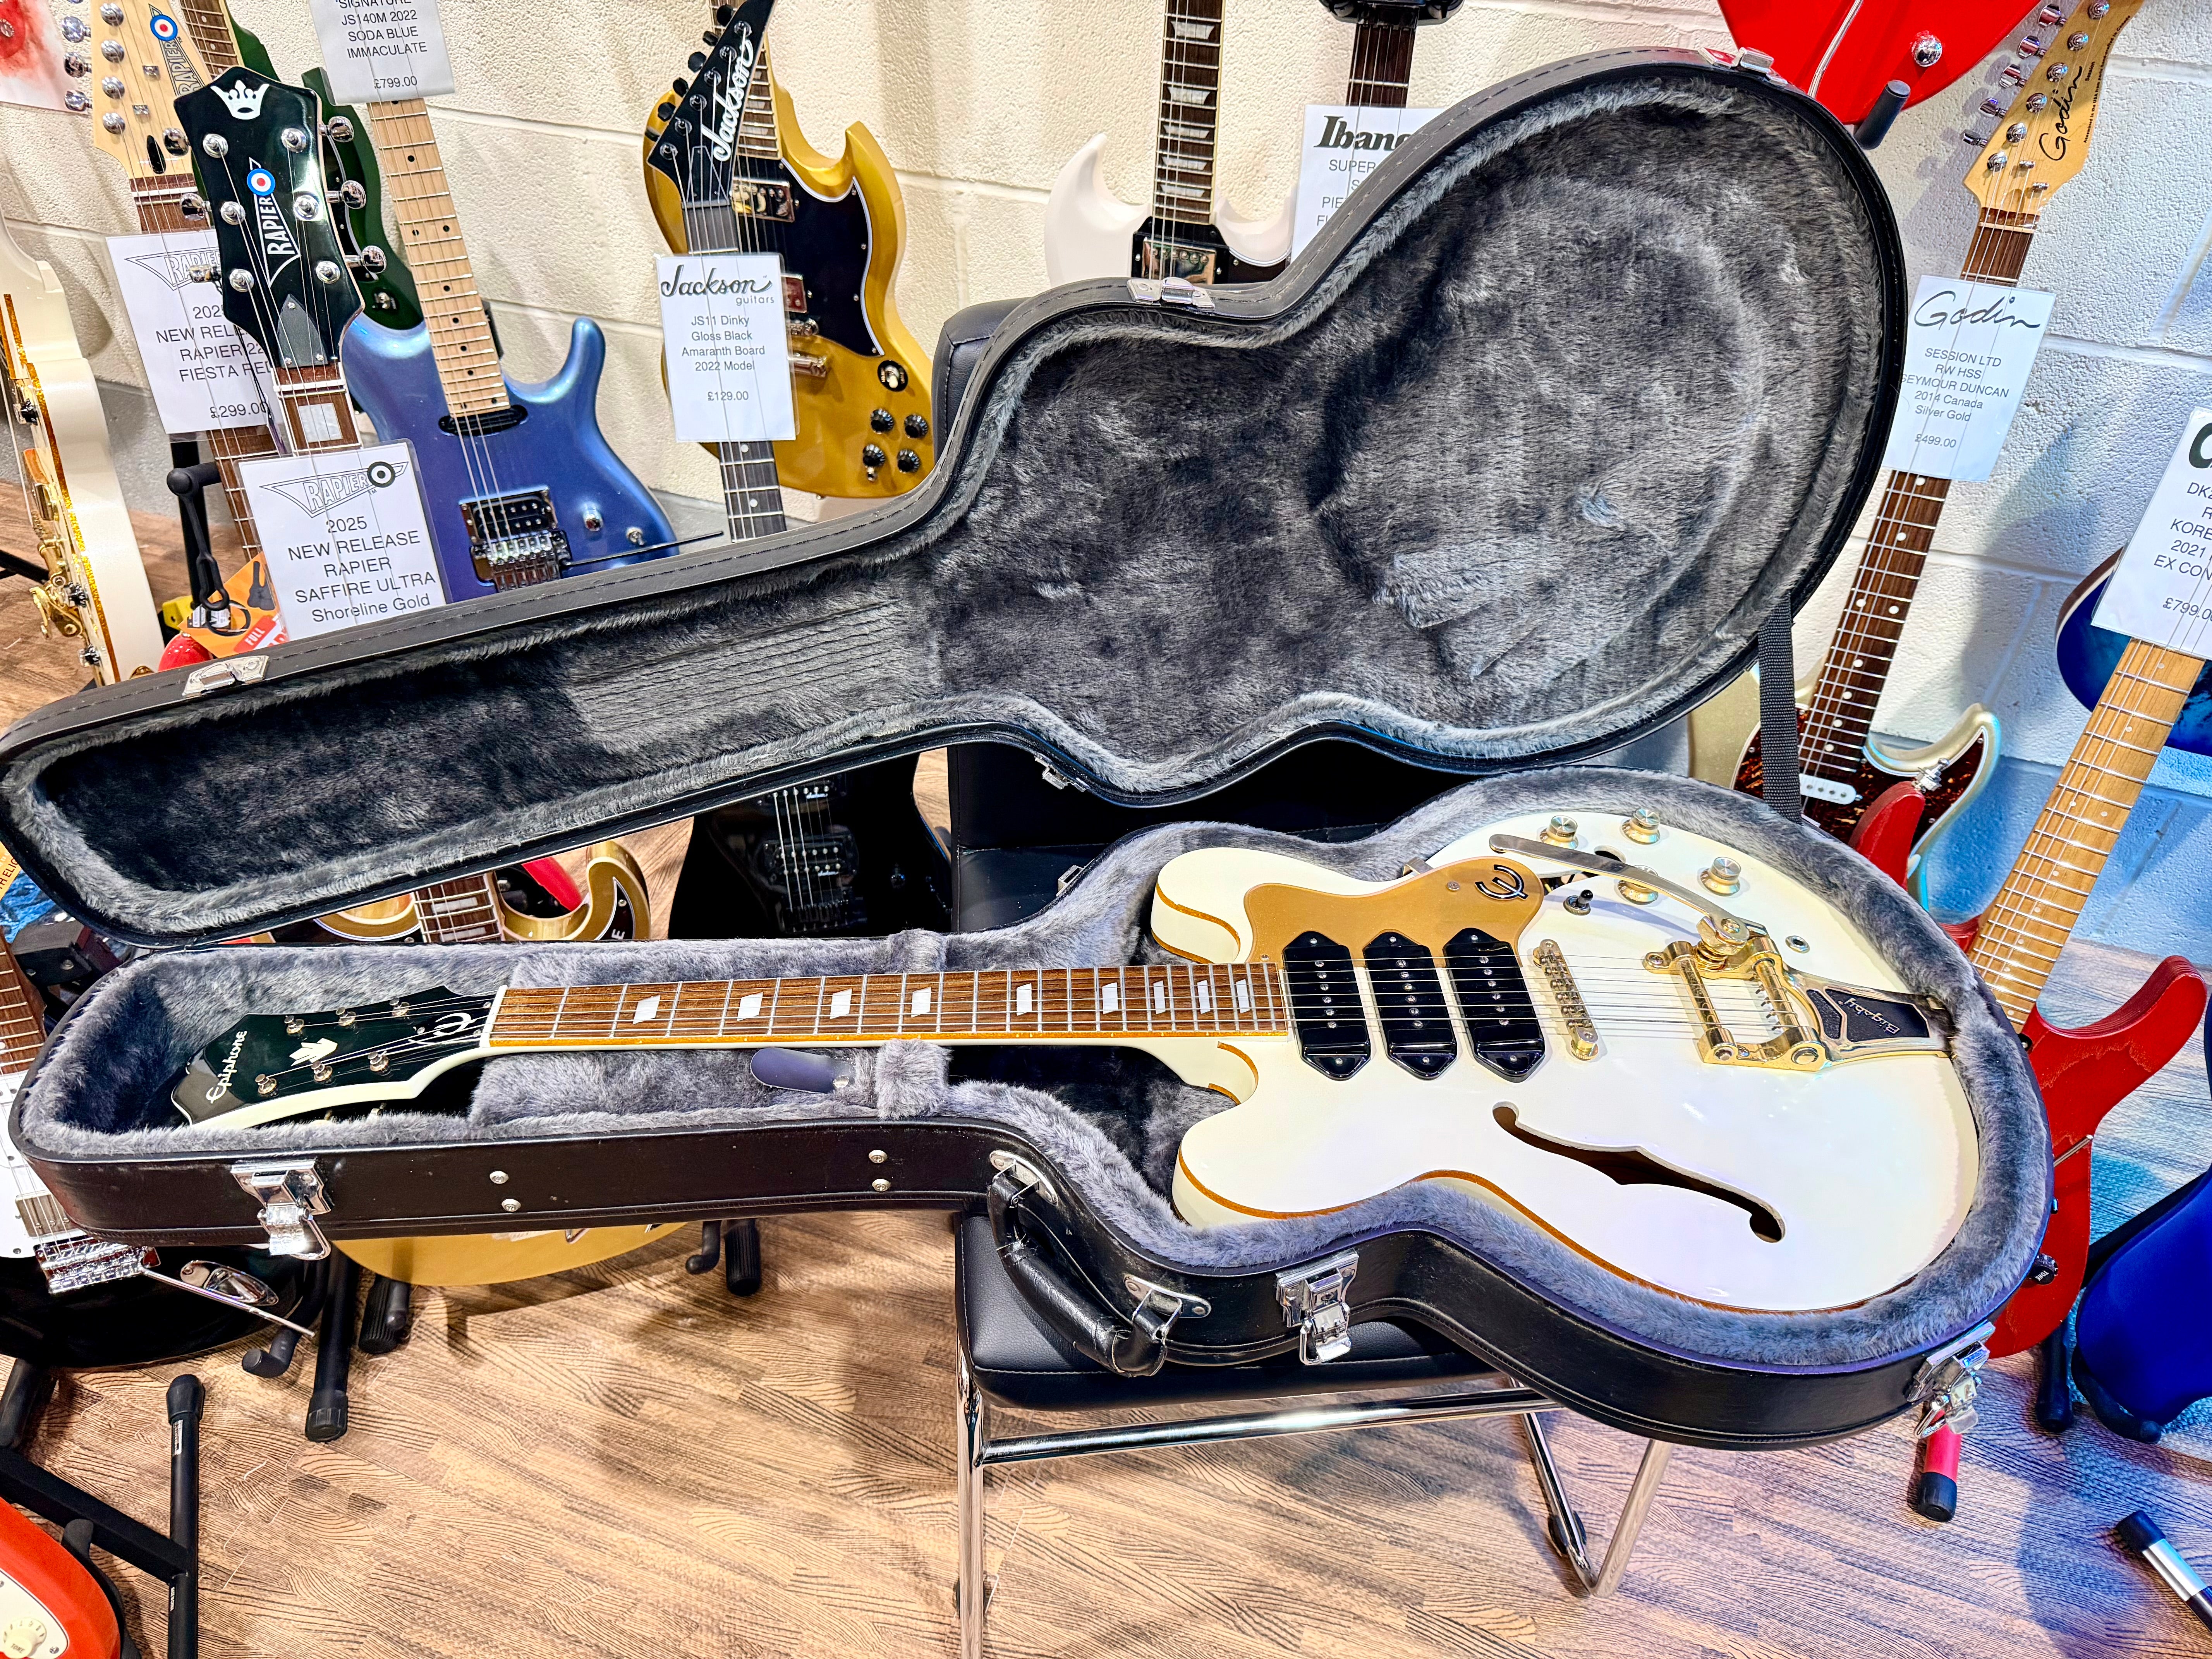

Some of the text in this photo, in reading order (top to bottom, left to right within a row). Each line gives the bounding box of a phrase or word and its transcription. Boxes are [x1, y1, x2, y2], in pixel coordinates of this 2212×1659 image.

[342, 10, 417, 25] JS140M 2022
[349, 26, 418, 41] SODA BLUE
[347, 42, 427, 58] IMMACULATE
[164, 39, 202, 95] RAPIER
[374, 76, 417, 89] £799.00
[701, 40, 753, 161] Jackson
[2039, 66, 2082, 161] Godin
[1329, 159, 1376, 173] SUPER
[1322, 197, 1346, 208] PIE
[259, 196, 295, 254] RAPIER
[661, 264, 773, 297] Jackson
[736, 295, 775, 306] guitars
[193, 305, 223, 319] 202
[1914, 291, 2040, 330] Godin
[691, 316, 749, 327] JS11 Dinky
[156, 325, 247, 343] NEW RELE
[692, 331, 752, 341] Gloss Black
[180, 345, 243, 361] RAPIER
[682, 346, 765, 356] Amaranth Board
[1925, 348, 2001, 367] SESSION LTD
[179, 365, 239, 382] FIESTA
[695, 361, 755, 371] 2022 Model
[1935, 364, 1982, 379] RW HSS
[1901, 374, 2009, 398] SEYMOUR DUNCAN
[708, 391, 749, 401] £129.00
[1915, 390, 1983, 409] 2014 Canada
[210, 402, 268, 419] £299.00
[1915, 405, 1972, 422] Silver Gold
[1915, 434, 1956, 448] £499.00
[2189, 422, 2212, 469] C
[302, 473, 369, 512] RAPIER
[326, 517, 367, 533] 2025
[288, 531, 420, 560] NEW RELEASE
[2171, 539, 2206, 558] 2021
[324, 557, 392, 577] RAPIER
[2154, 555, 2177, 570] EX
[295, 572, 436, 603] SAFFIRE ULTRA
[312, 594, 430, 622] Shoreline Gold
[2163, 598, 2212, 622] £799.0
[244, 627, 265, 646] FULL
[1843, 998, 1901, 1035] Bigsby
[206, 1030, 247, 1104] Epiphone
[2035, 1270, 2049, 1281] TONE
[10, 1643, 25, 1654] TONE
